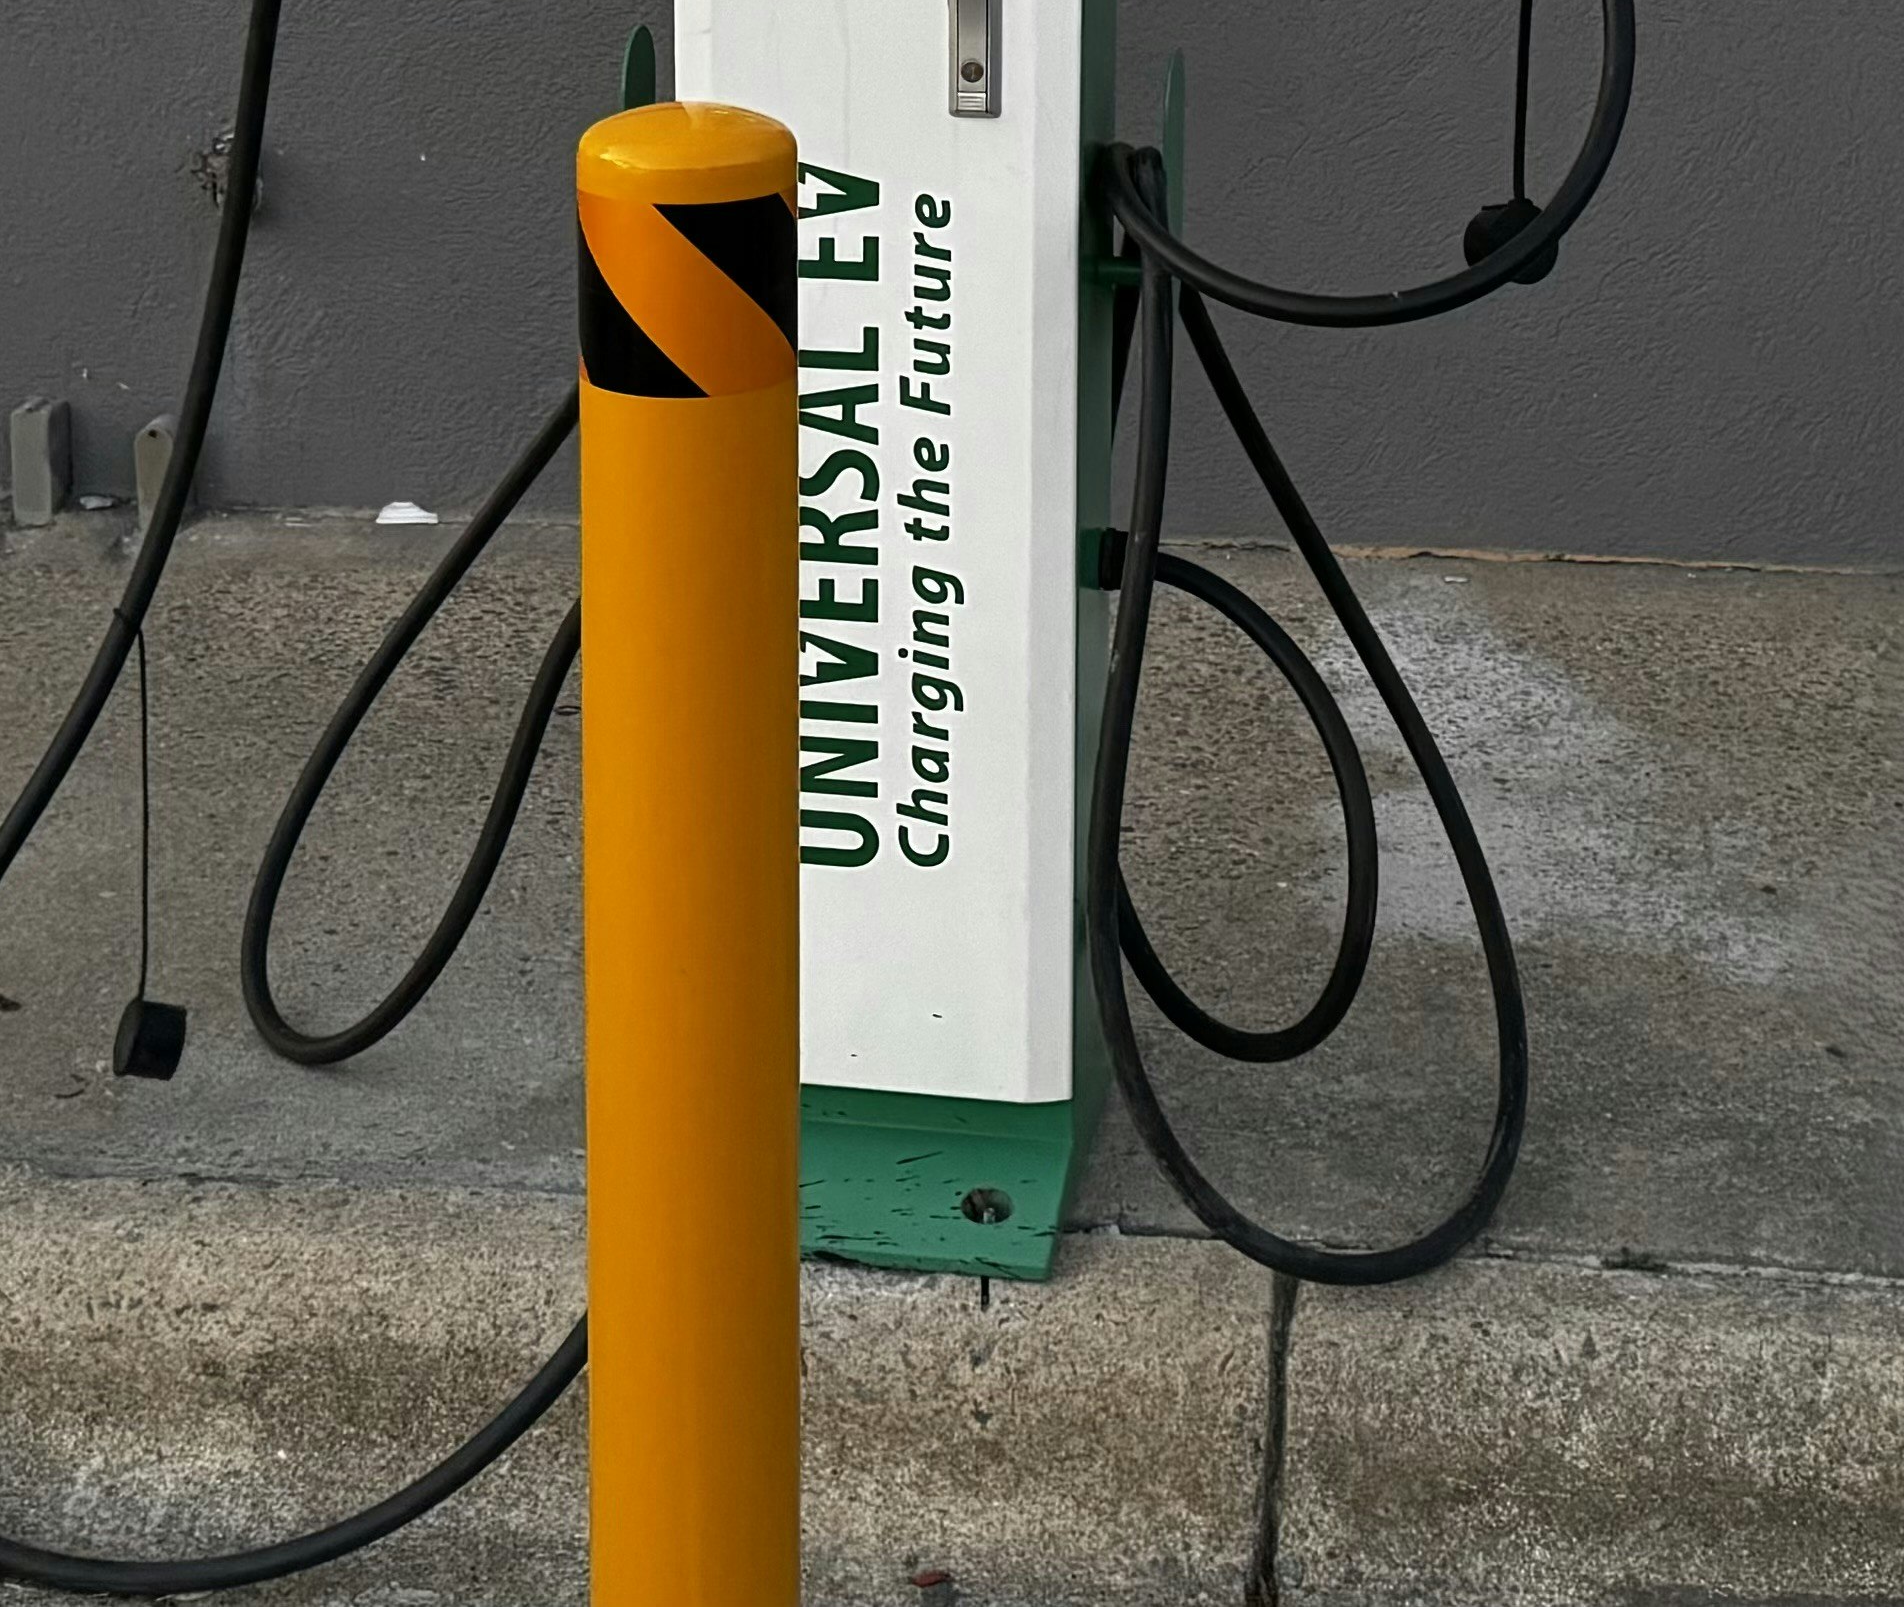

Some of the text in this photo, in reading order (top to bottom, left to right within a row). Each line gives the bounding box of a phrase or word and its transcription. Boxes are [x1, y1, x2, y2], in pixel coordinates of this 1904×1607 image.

[798, 161, 880, 868] UNIVERSAL EV
[895, 193, 965, 868] Charging the Future
